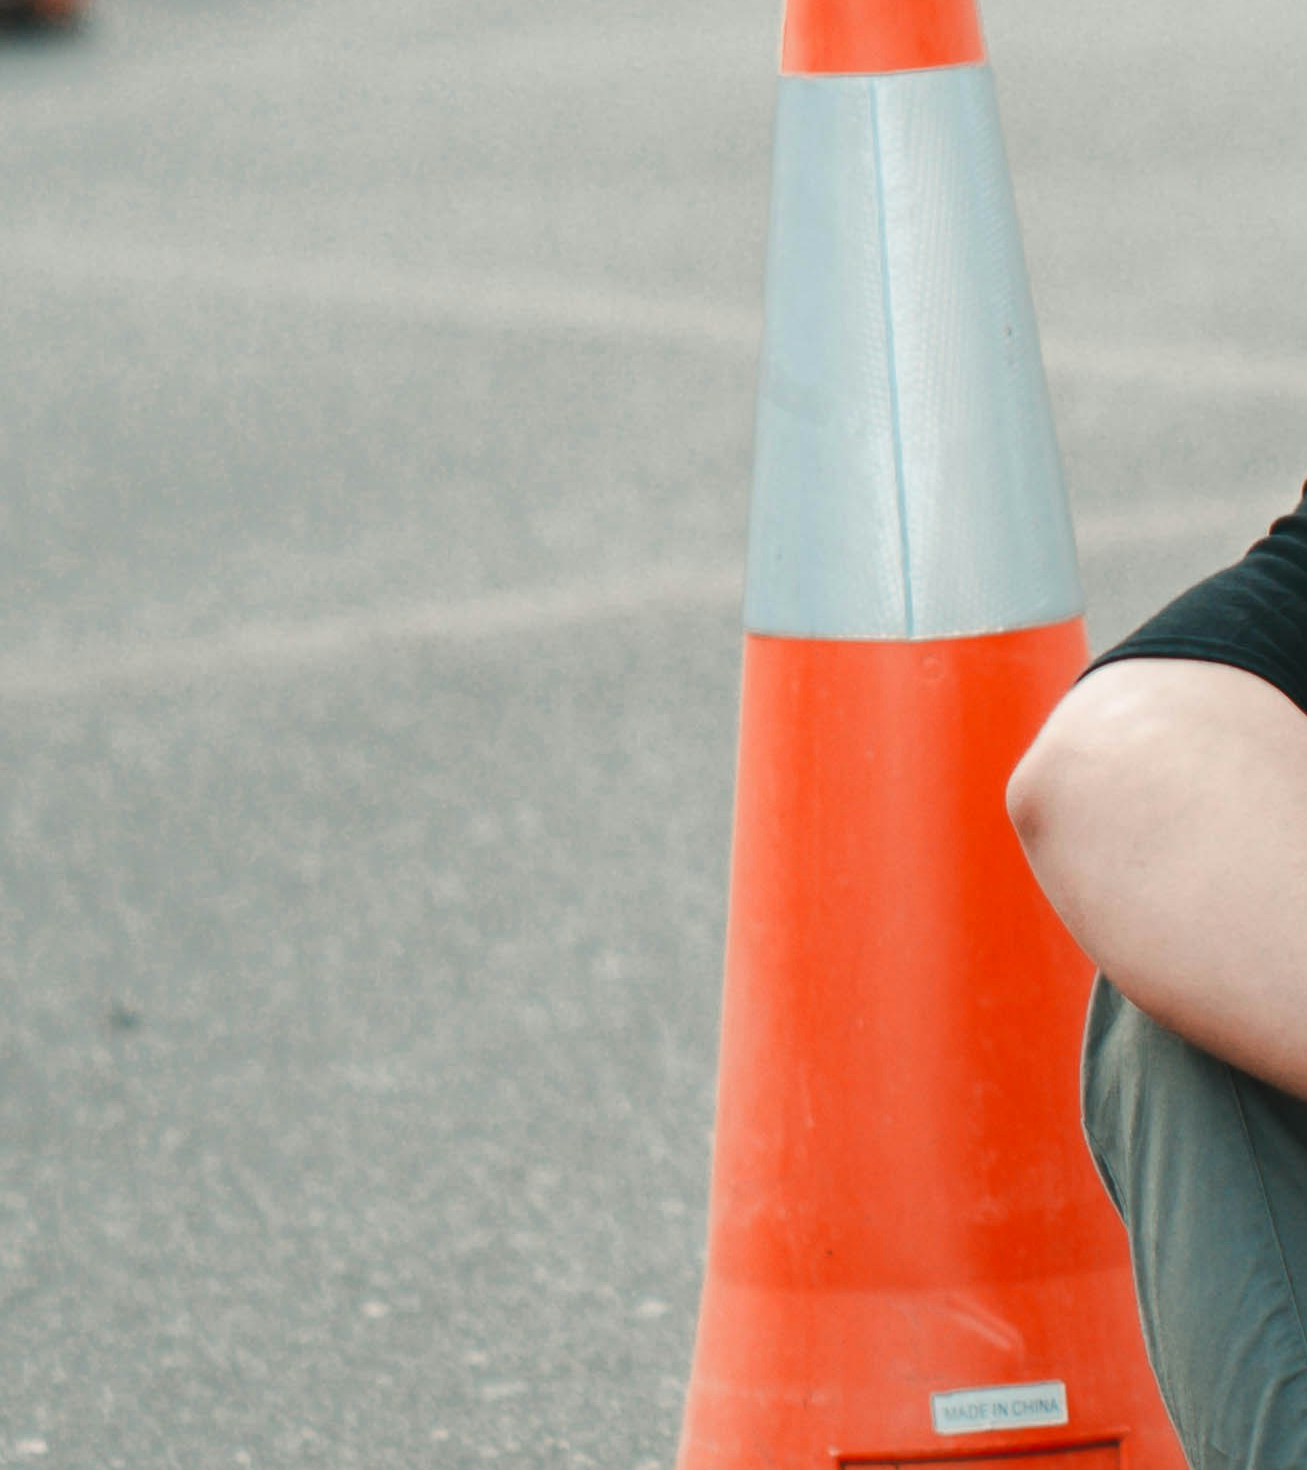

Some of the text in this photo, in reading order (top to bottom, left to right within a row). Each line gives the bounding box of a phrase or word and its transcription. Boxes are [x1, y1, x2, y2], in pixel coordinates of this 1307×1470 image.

[943, 1397, 1060, 1421] MADE IN CHINA
